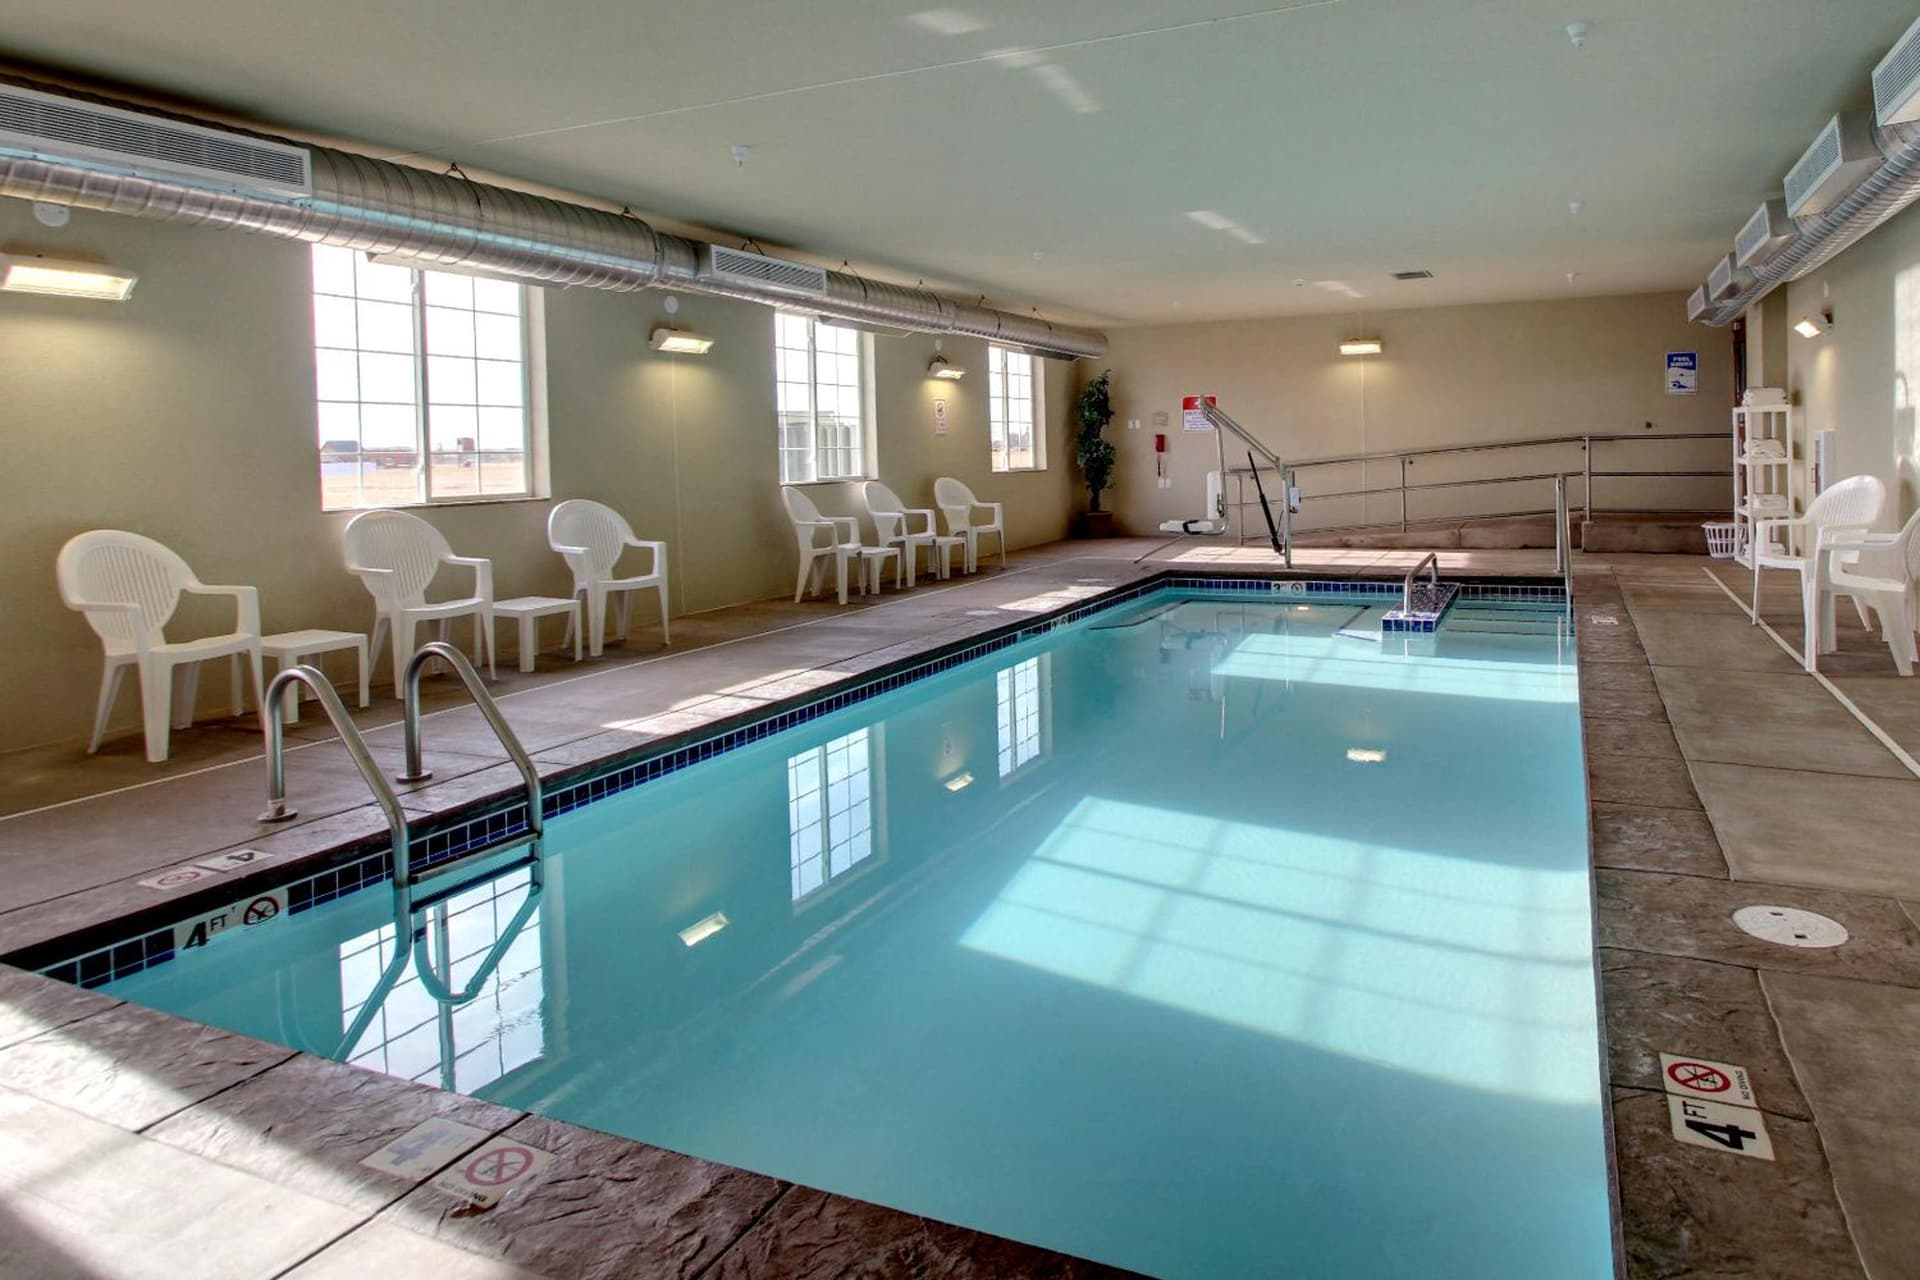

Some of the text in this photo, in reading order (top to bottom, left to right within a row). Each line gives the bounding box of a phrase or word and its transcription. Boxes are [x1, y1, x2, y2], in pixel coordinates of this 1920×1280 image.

[183, 914, 228, 950] 4 FT
[1741, 1091, 1750, 1100] NO
[1682, 1101, 1757, 1150] 4 FT
